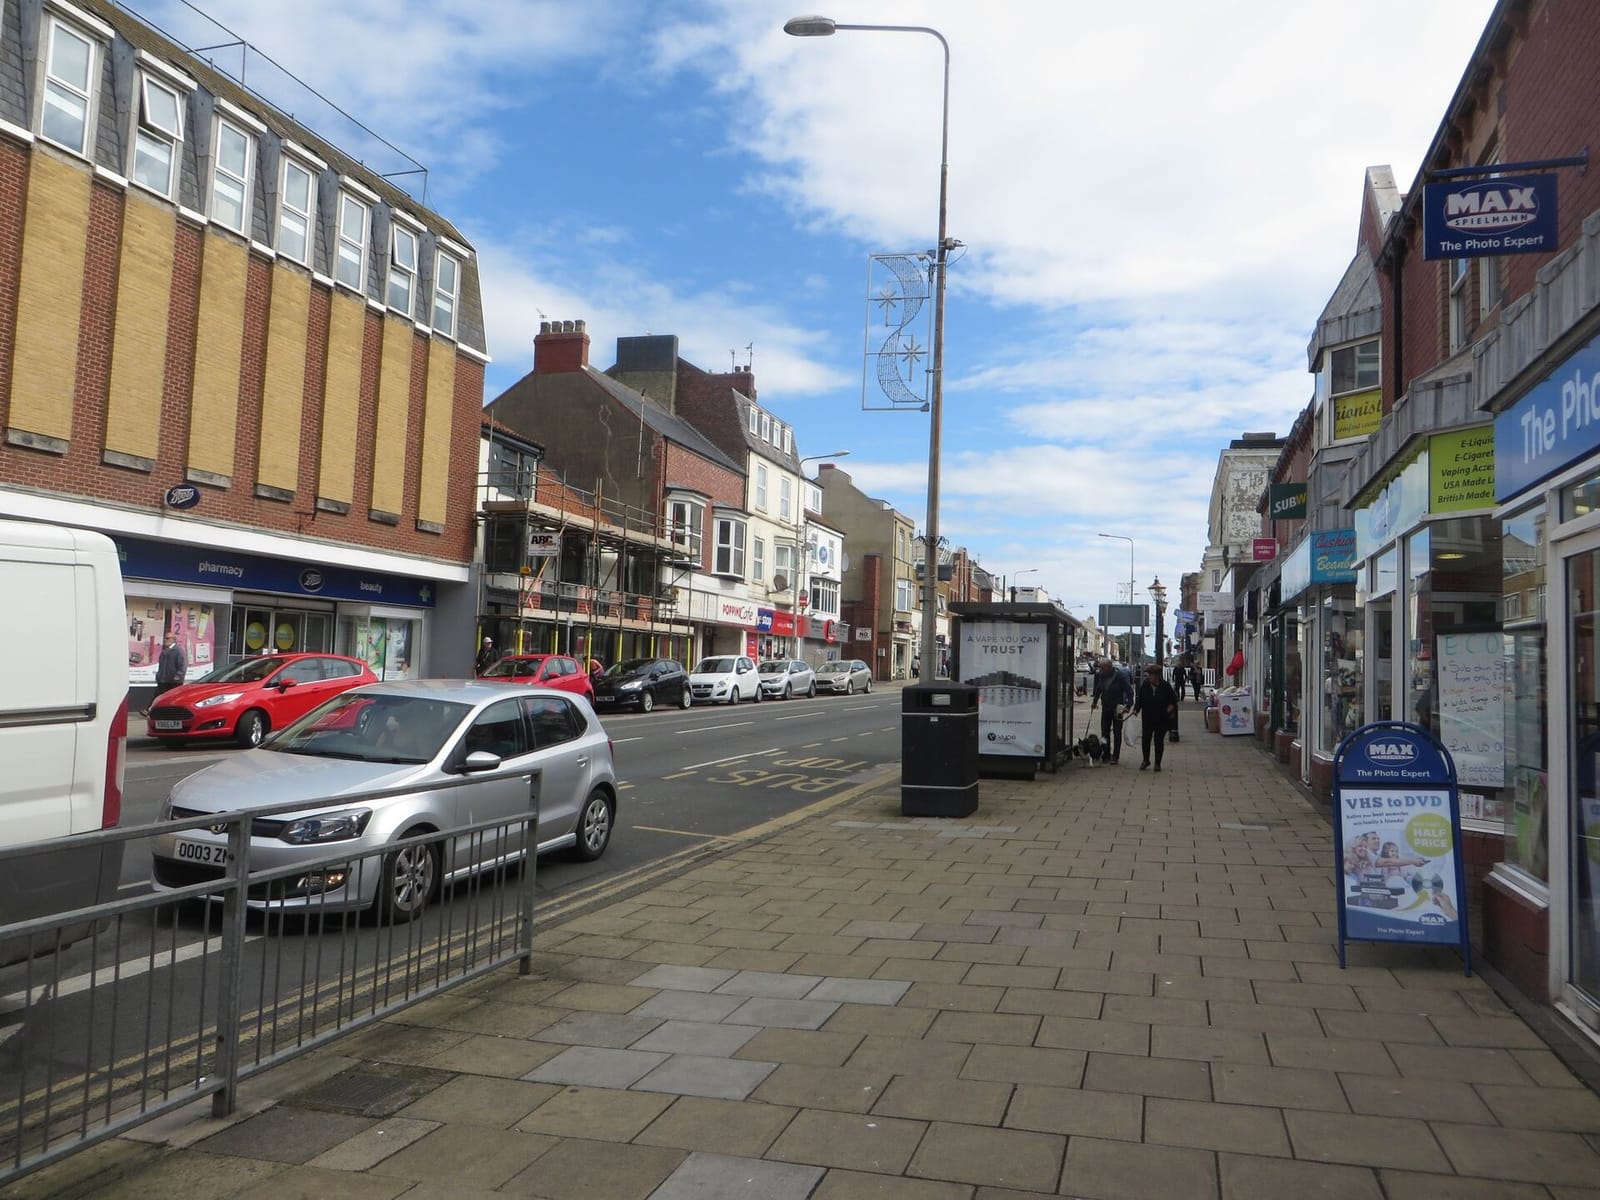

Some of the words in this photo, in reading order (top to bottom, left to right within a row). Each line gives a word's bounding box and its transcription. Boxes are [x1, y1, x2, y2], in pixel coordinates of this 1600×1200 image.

[1447, 187, 1537, 215] MAX
[1455, 213, 1529, 226] SPIELMANN
[1440, 241, 1462, 251] The
[1465, 238, 1500, 250] Photo
[1504, 235, 1544, 248] Expert
[1521, 404, 1556, 464] The
[1441, 466, 1471, 477] Vaping
[1443, 481, 1460, 490] USA
[1462, 477, 1486, 487] Made
[1437, 494, 1465, 503] British
[1466, 490, 1490, 500] Made
[531, 535, 553, 544] ABC
[198, 561, 245, 577] pharmacy
[360, 582, 383, 594] beauty
[175, 602, 182, 614] 3
[174, 622, 181, 636] 2
[967, 635, 974, 643] A
[976, 636, 998, 644] VAPE
[1000, 636, 1018, 644] YOU
[1021, 636, 1040, 644] CAN
[982, 645, 1025, 655] TRUST
[1369, 744, 1415, 756] MAX
[1357, 769, 1372, 777] The
[1374, 769, 1400, 778] Photo
[1401, 769, 1431, 779] Expert
[706, 769, 850, 793] BUS
[1346, 796, 1383, 810] VHS
[1387, 797, 1403, 808] to
[1405, 795, 1442, 807] DVD
[1413, 827, 1448, 838] HALF
[1413, 838, 1449, 849] PRICE
